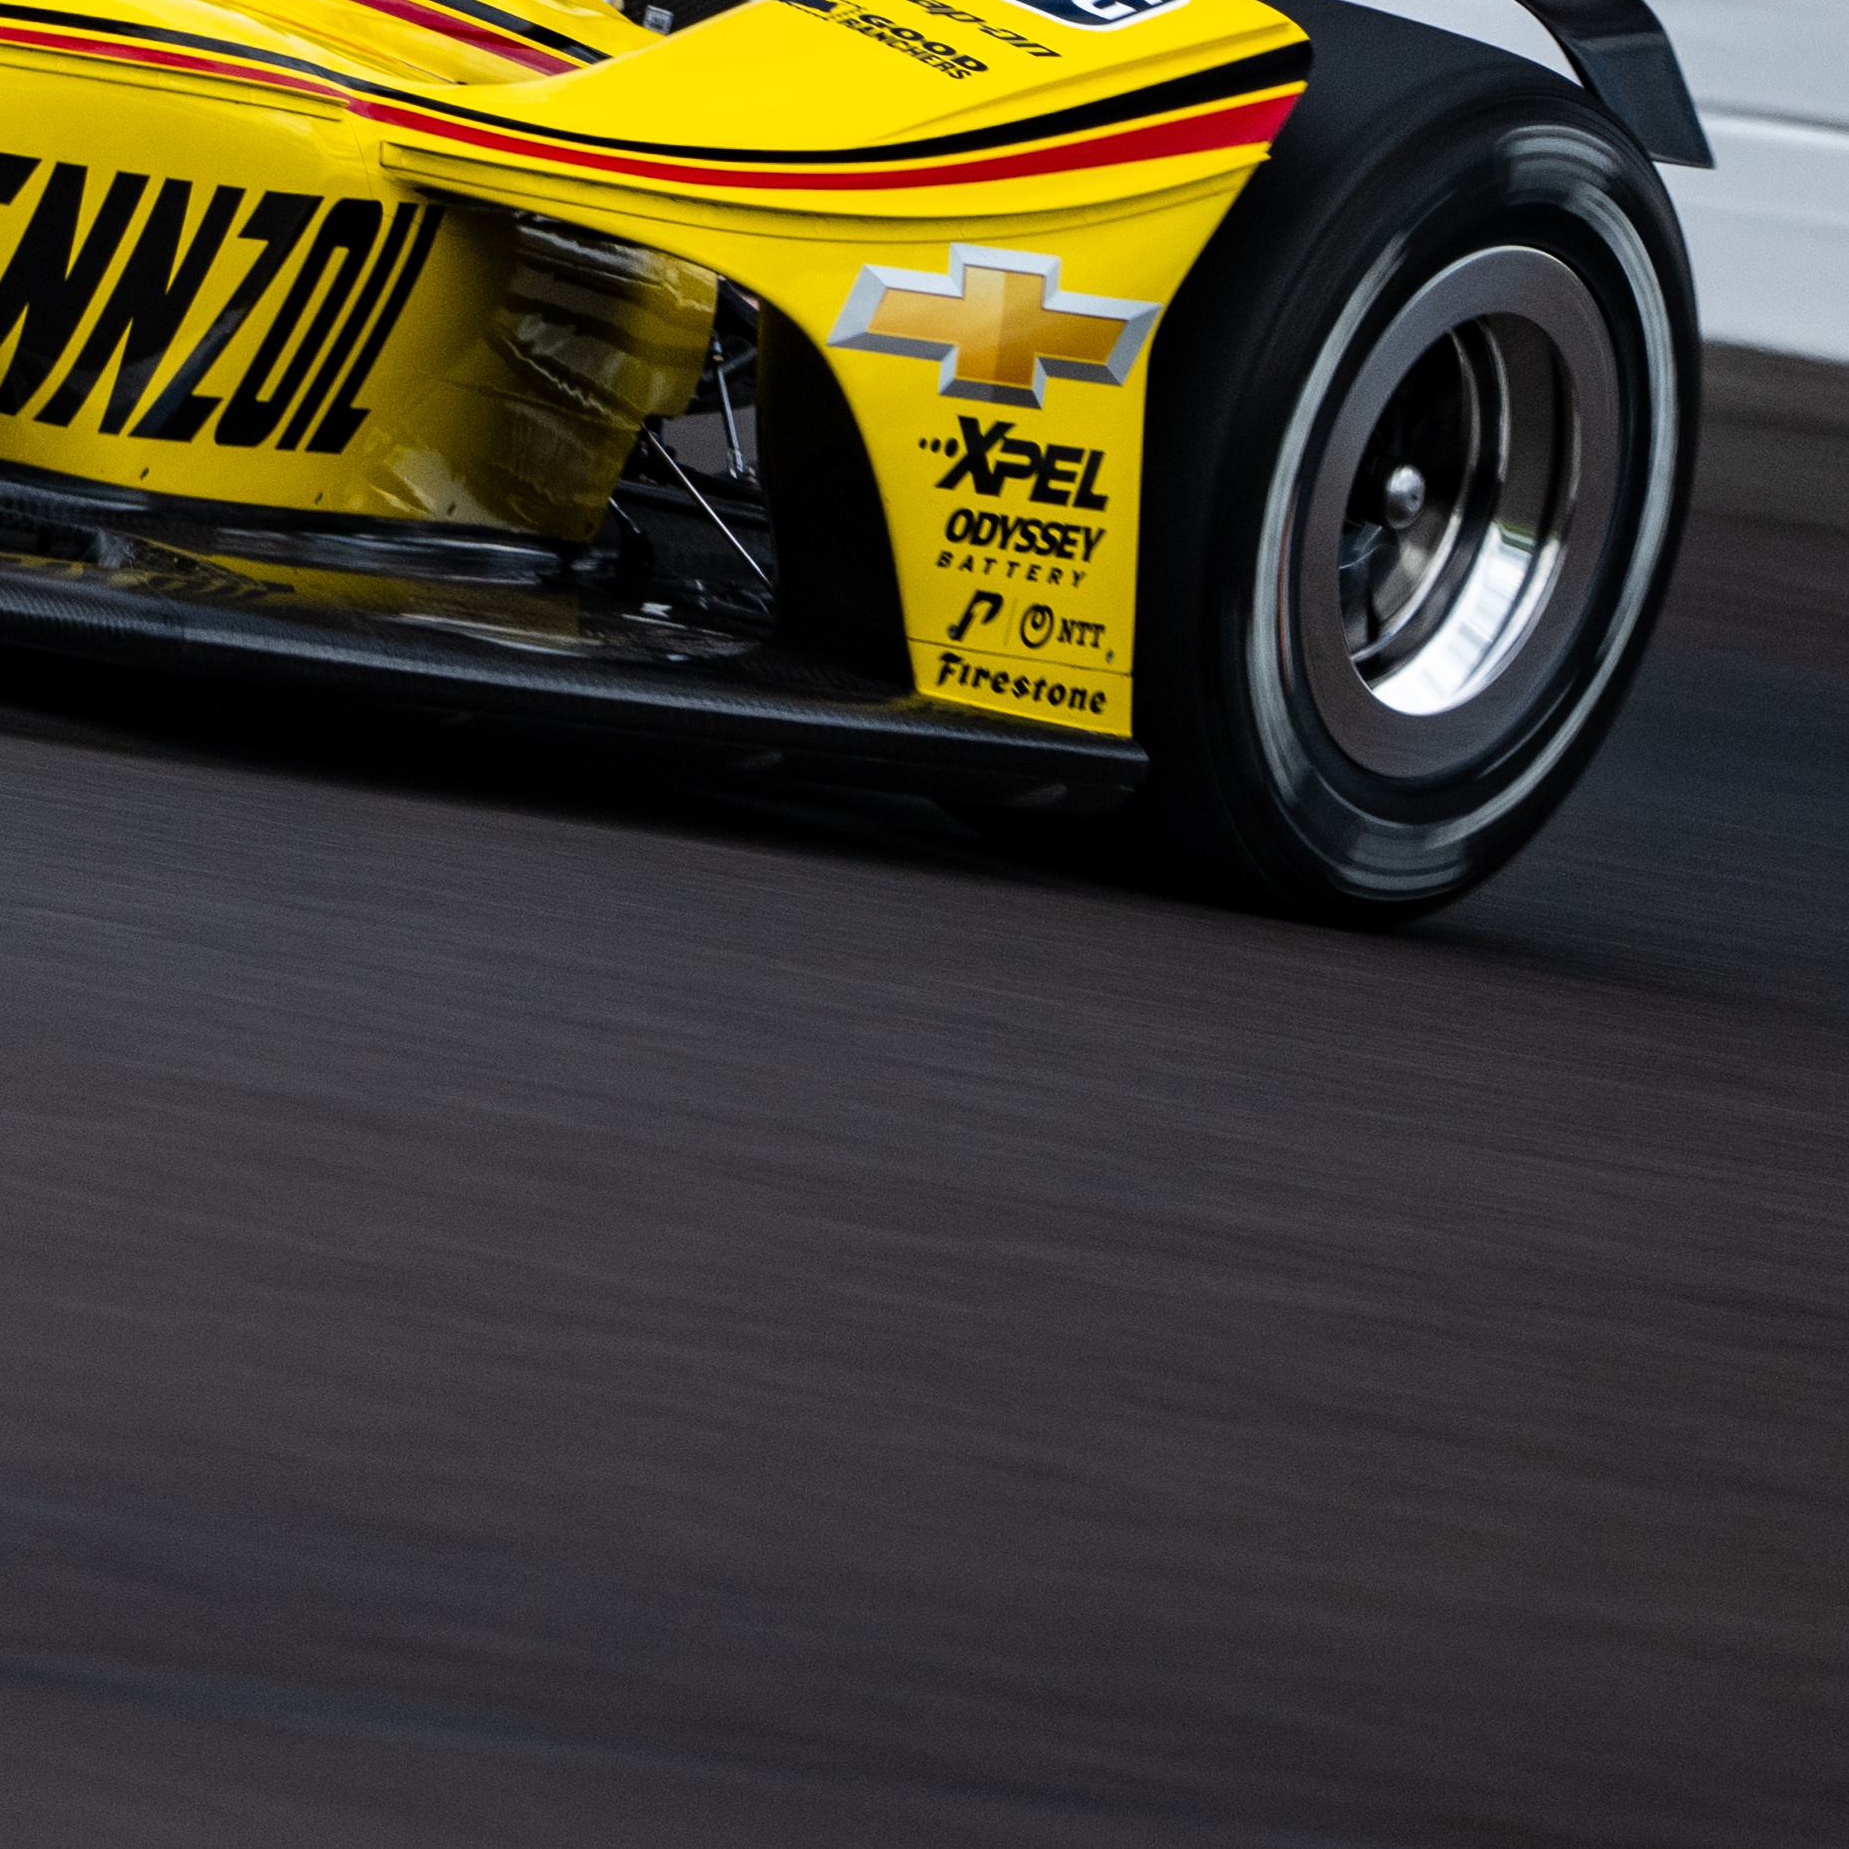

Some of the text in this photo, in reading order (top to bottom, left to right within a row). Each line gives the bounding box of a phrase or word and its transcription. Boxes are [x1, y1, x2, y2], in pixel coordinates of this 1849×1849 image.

[839, 17, 973, 81] RANCHERS
[858, 13, 990, 73] GOOD
[935, 414, 1111, 512] XPEL
[944, 508, 1108, 563] ODYSSEY
[935, 550, 1088, 589] BATTERY
[1056, 616, 1108, 650] NTT
[934, 650, 1110, 717] Firestone
